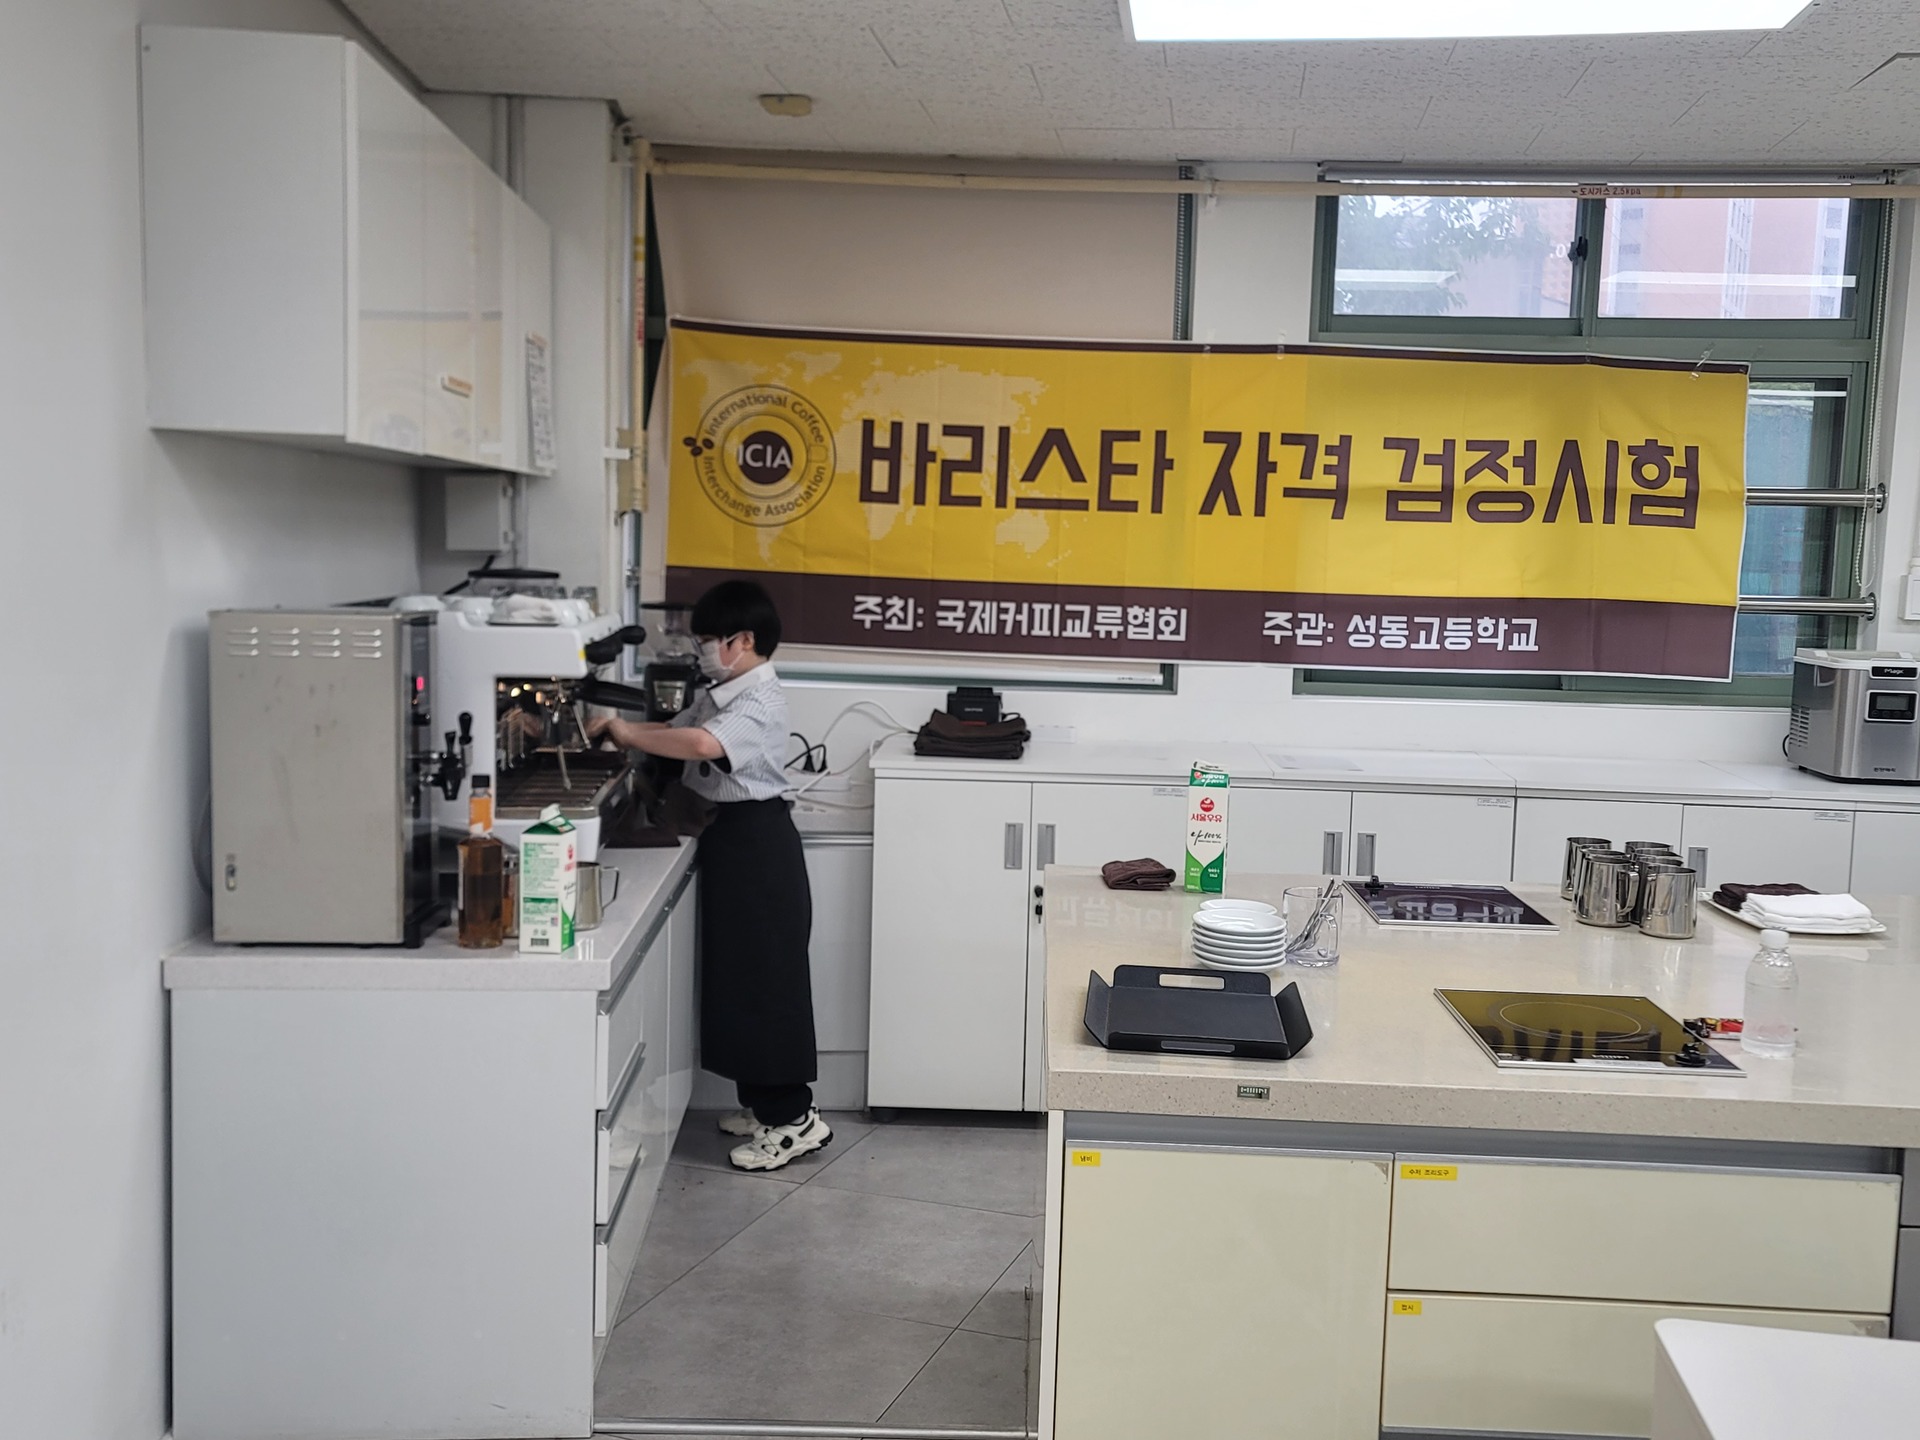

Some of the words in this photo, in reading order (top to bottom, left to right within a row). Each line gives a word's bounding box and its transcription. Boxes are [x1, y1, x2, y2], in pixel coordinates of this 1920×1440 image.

[1580, 187, 1610, 196] 도시가스
[705, 392, 788, 437] International
[791, 401, 825, 444] Coffee
[737, 443, 793, 469] ICIA
[859, 418, 1175, 515] 바리스타
[1198, 430, 1353, 520] 자격
[1383, 438, 1700, 530] 검정시험
[704, 456, 762, 518] Interchange
[764, 465, 827, 517] Association
[852, 594, 925, 632] 주최:
[935, 600, 1188, 642] 국제커피교류협회
[1262, 610, 1334, 648] 주관:
[1346, 613, 1540, 652] 성동고등학교
[1191, 813, 1222, 822] 서울우유
